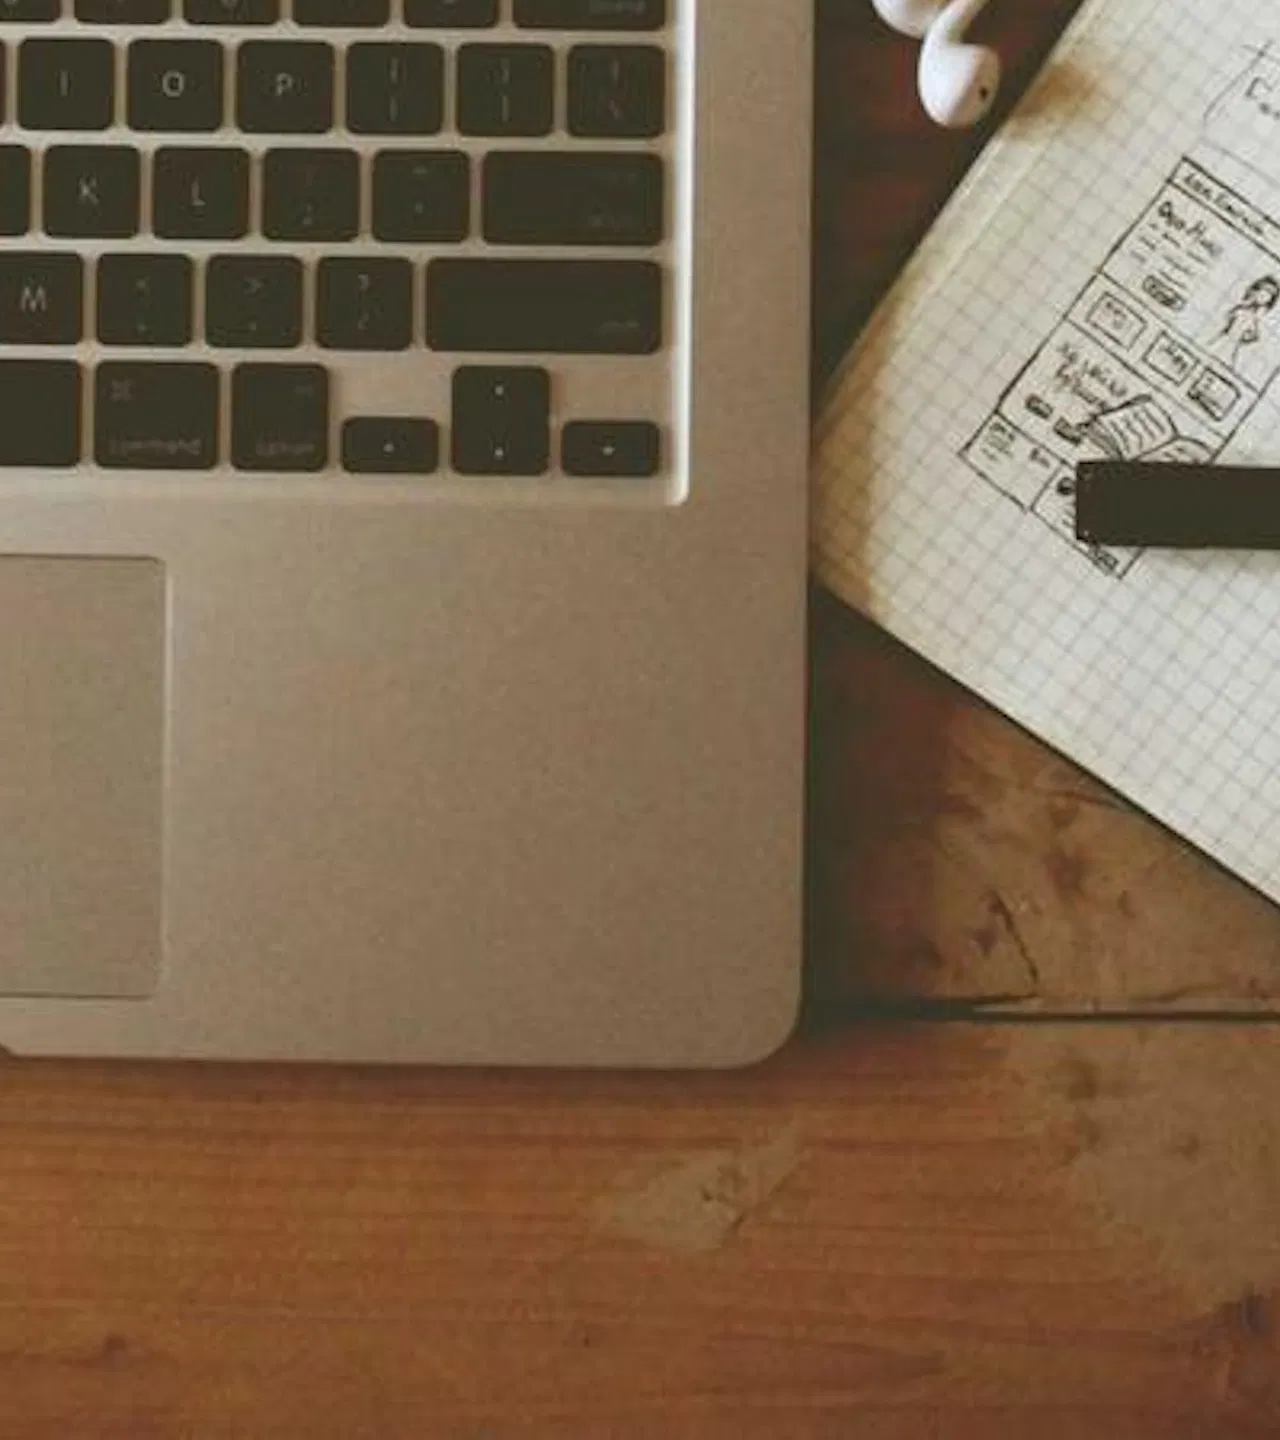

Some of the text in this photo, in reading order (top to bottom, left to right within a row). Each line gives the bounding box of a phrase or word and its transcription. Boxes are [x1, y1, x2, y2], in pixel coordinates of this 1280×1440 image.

[161, 70, 186, 98] O
[274, 71, 295, 98] P
[78, 177, 100, 206] K
[190, 179, 208, 208] L
[20, 285, 47, 313] M
